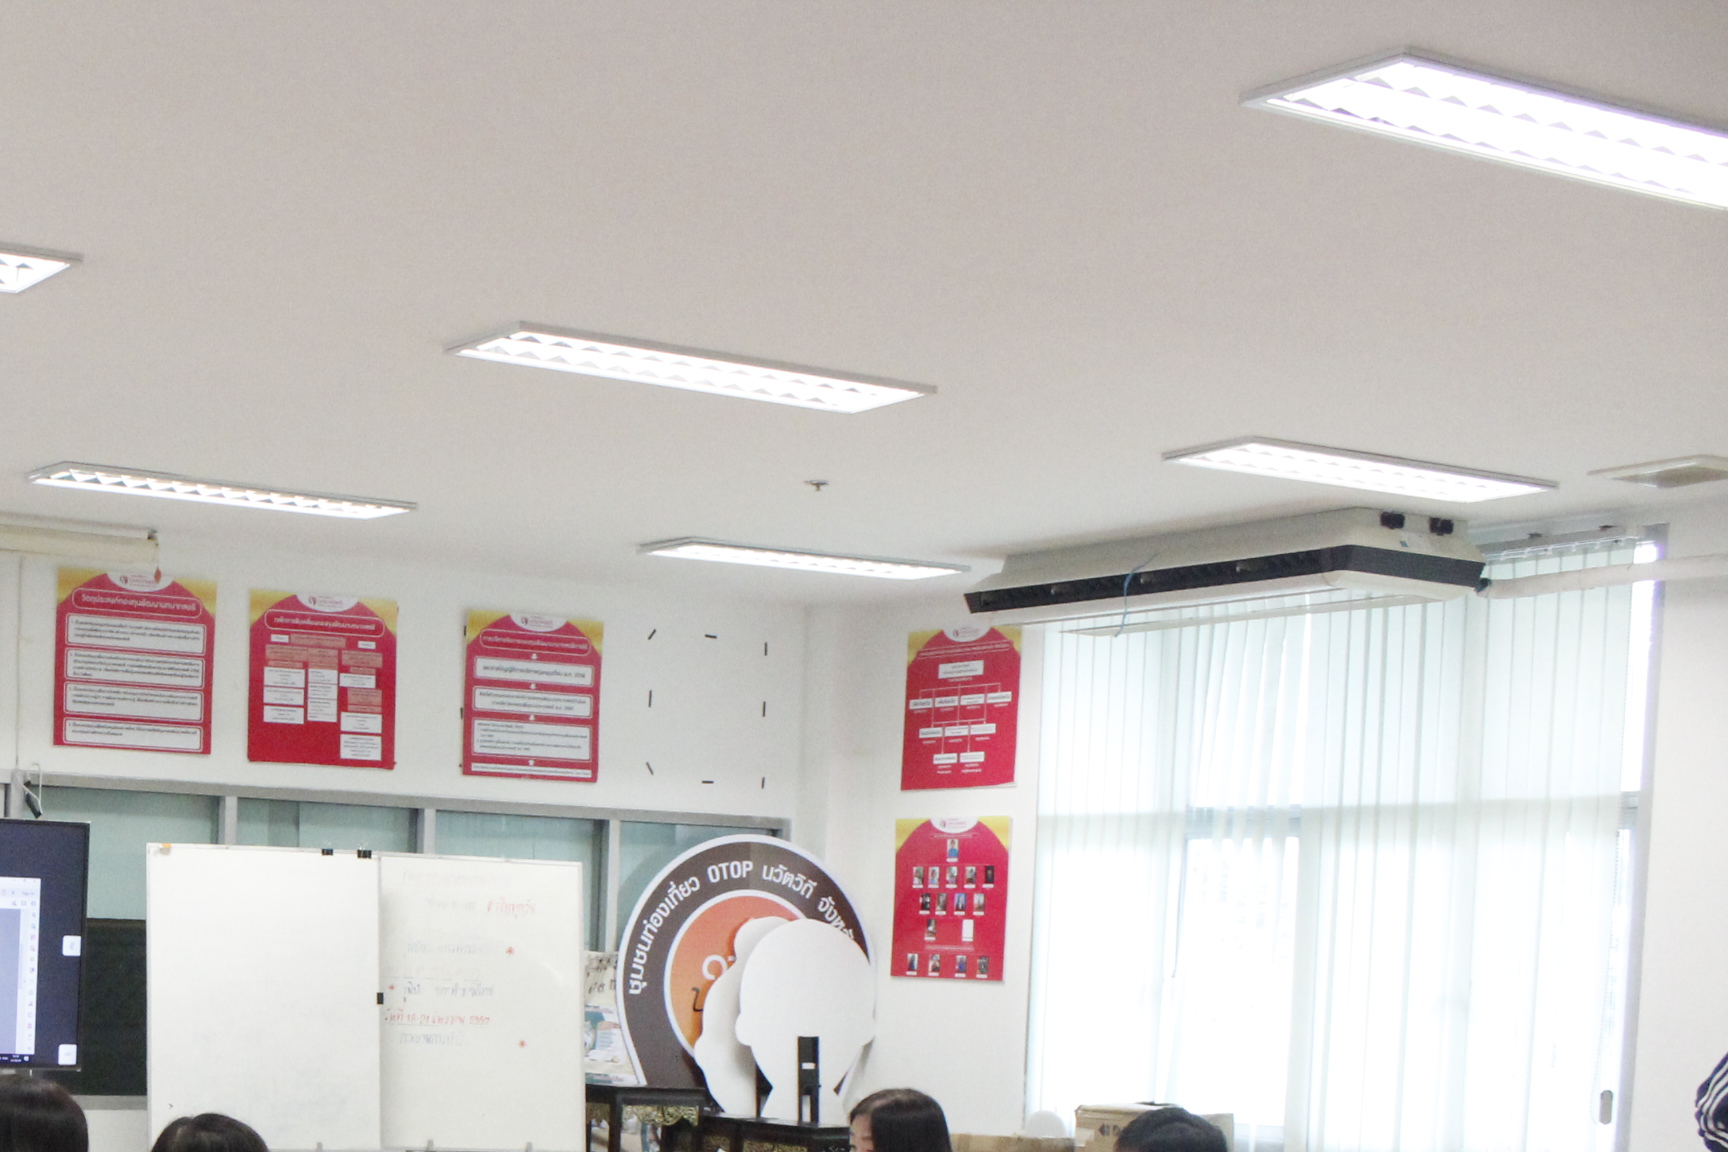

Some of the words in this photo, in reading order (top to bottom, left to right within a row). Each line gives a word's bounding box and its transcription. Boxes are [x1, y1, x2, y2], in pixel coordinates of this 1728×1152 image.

[629, 876, 701, 995] ชุมชนท่องเที่ยว
[707, 860, 754, 883] OTOP
[762, 864, 818, 899] นวัตวิถี
